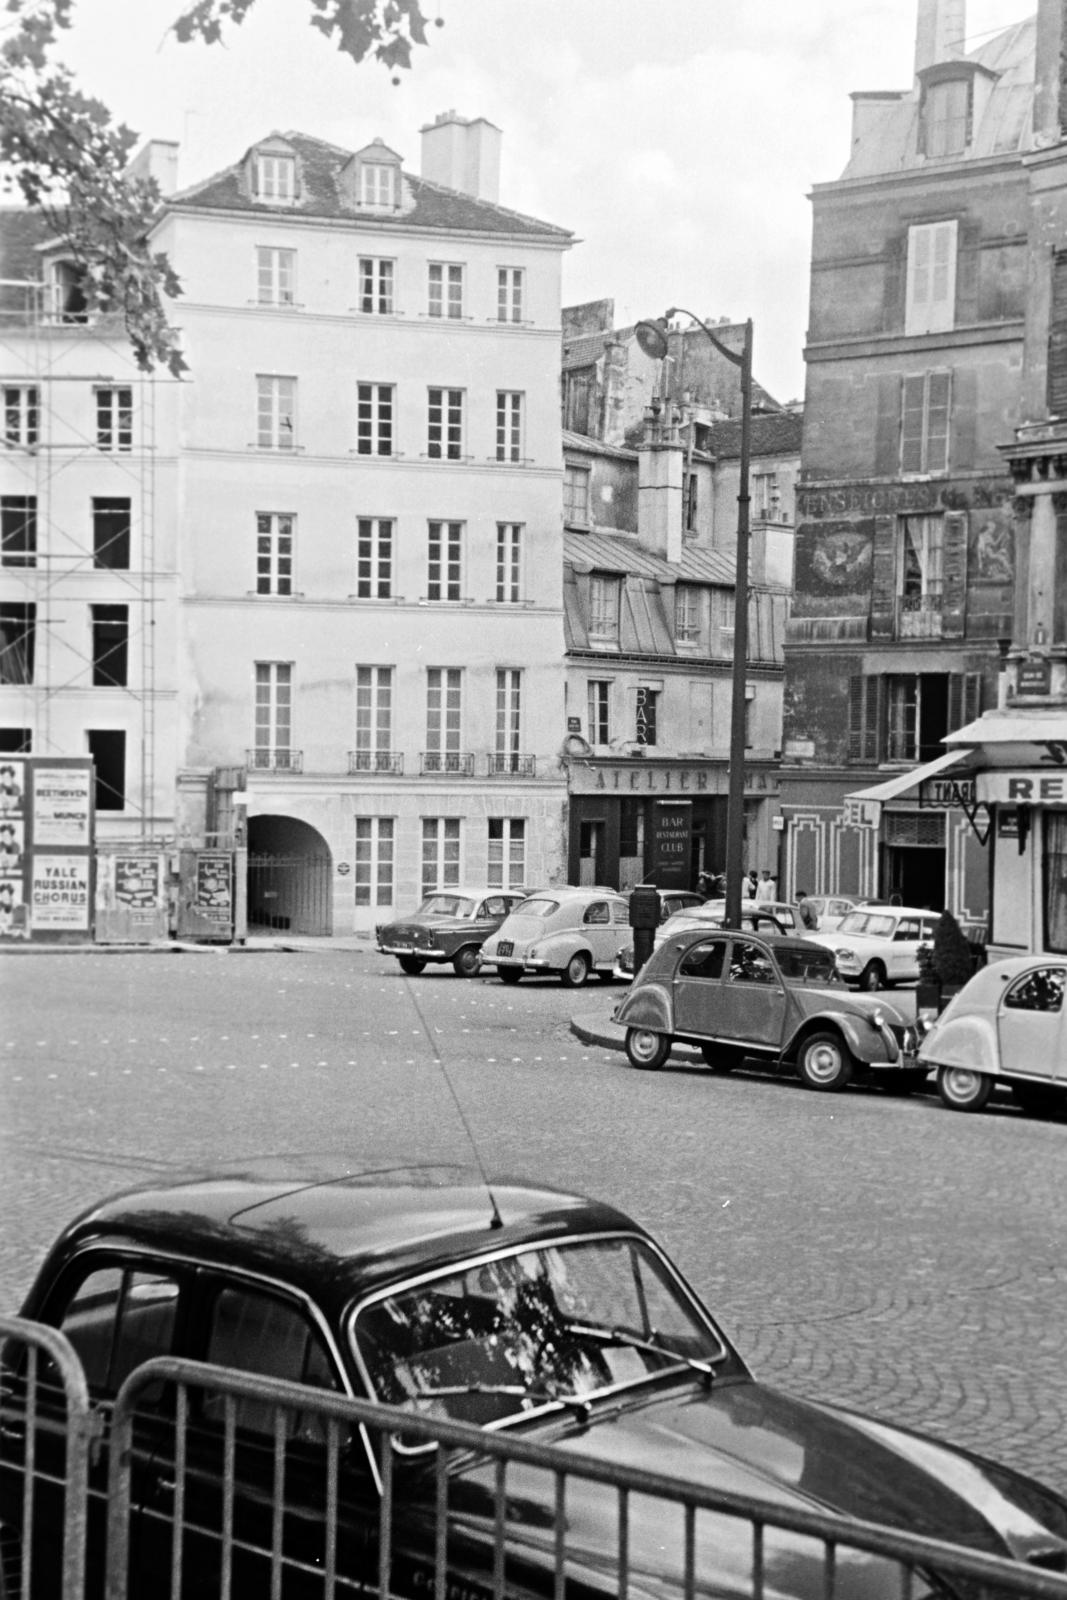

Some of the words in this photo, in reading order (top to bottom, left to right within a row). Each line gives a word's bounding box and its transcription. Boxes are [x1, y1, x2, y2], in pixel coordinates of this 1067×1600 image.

[636, 688, 647, 744] BAR
[595, 770, 708, 790] ATELIER
[36, 789, 87, 798] BEETHOVEN
[1009, 778, 1063, 799] RE
[661, 817, 684, 827] BAR
[656, 831, 688, 839] RESTAURANT
[661, 842, 684, 852] CLUB
[45, 867, 78, 878] YALE
[34, 879, 86, 890] RUSSIAN
[34, 892, 86, 903] CHORUS
